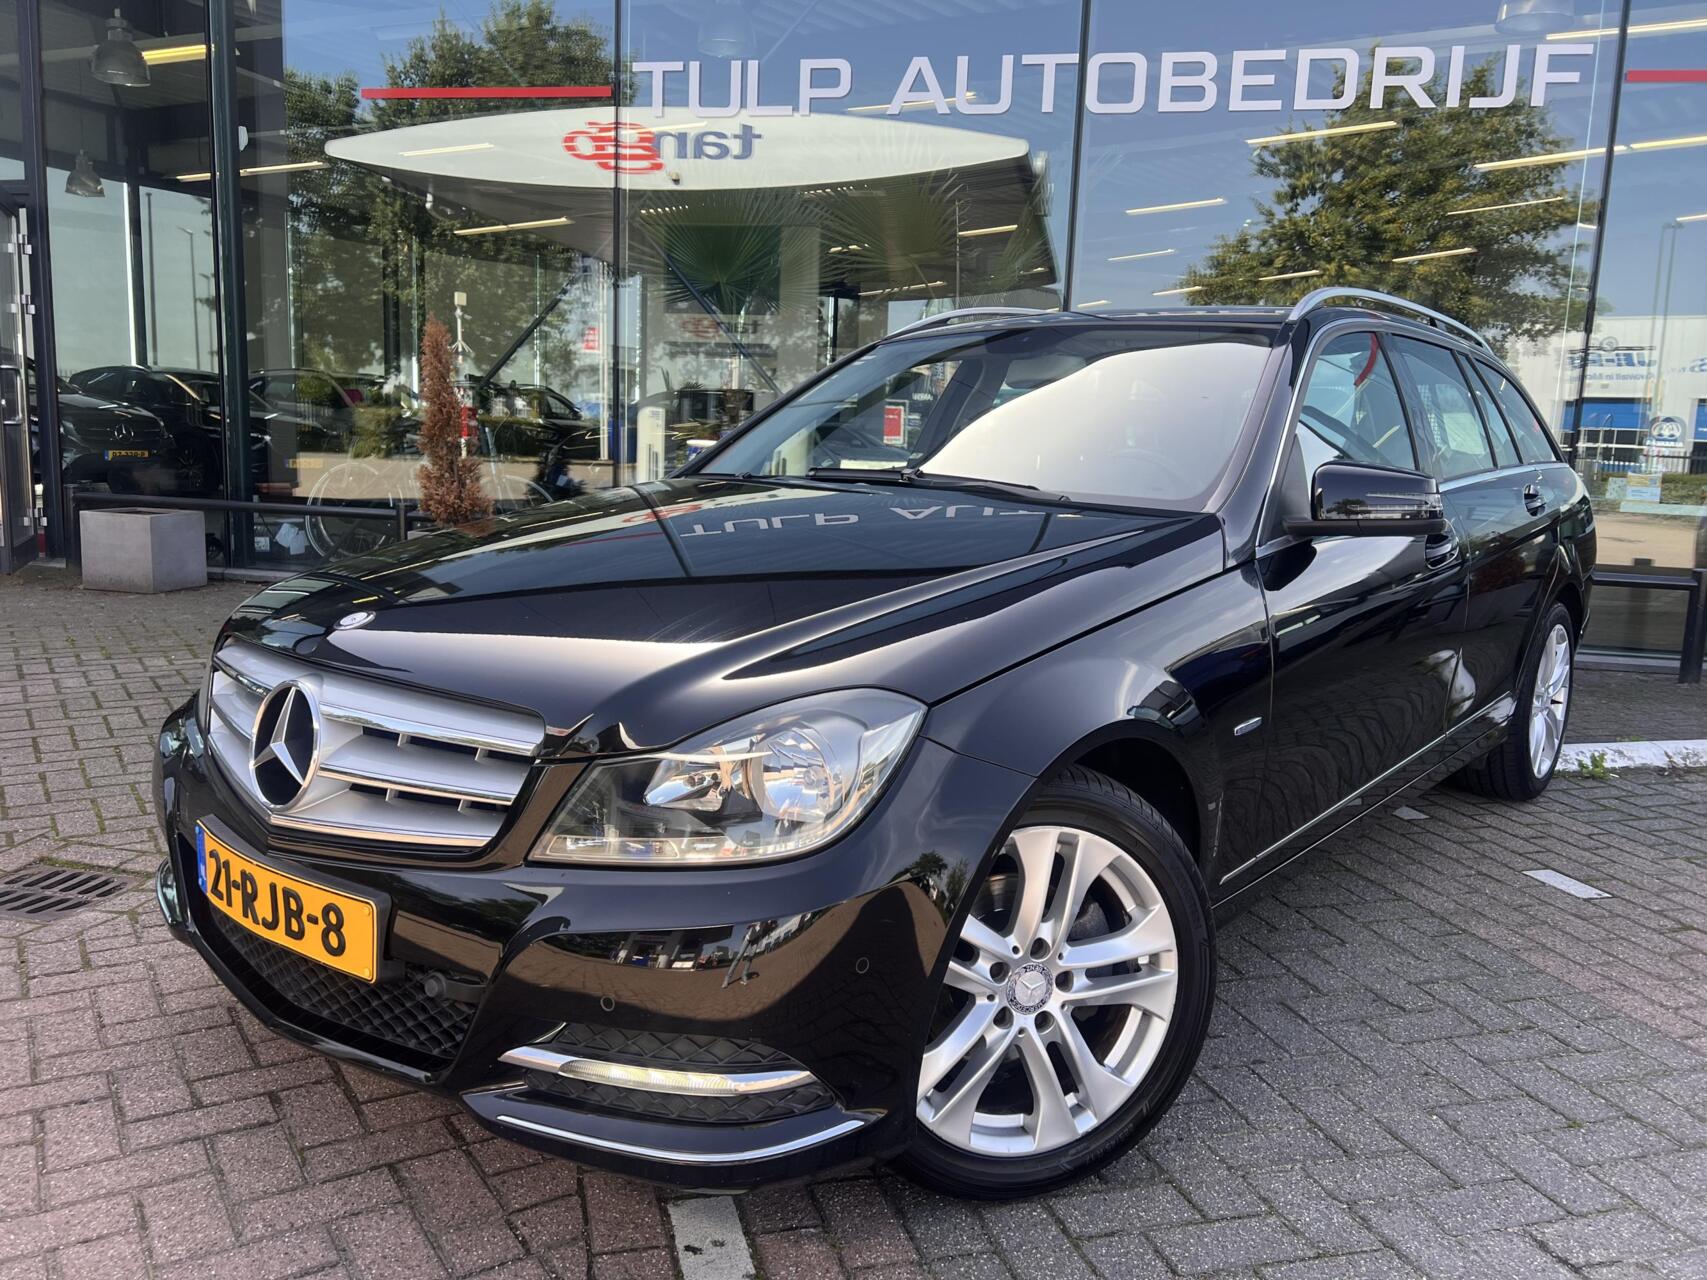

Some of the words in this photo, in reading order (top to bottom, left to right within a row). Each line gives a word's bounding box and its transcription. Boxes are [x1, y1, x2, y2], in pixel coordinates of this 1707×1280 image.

[632, 59, 852, 118] TULP
[886, 43, 1594, 115] AUTOBEDRIJF
[208, 848, 346, 957] 21-RJB-8
